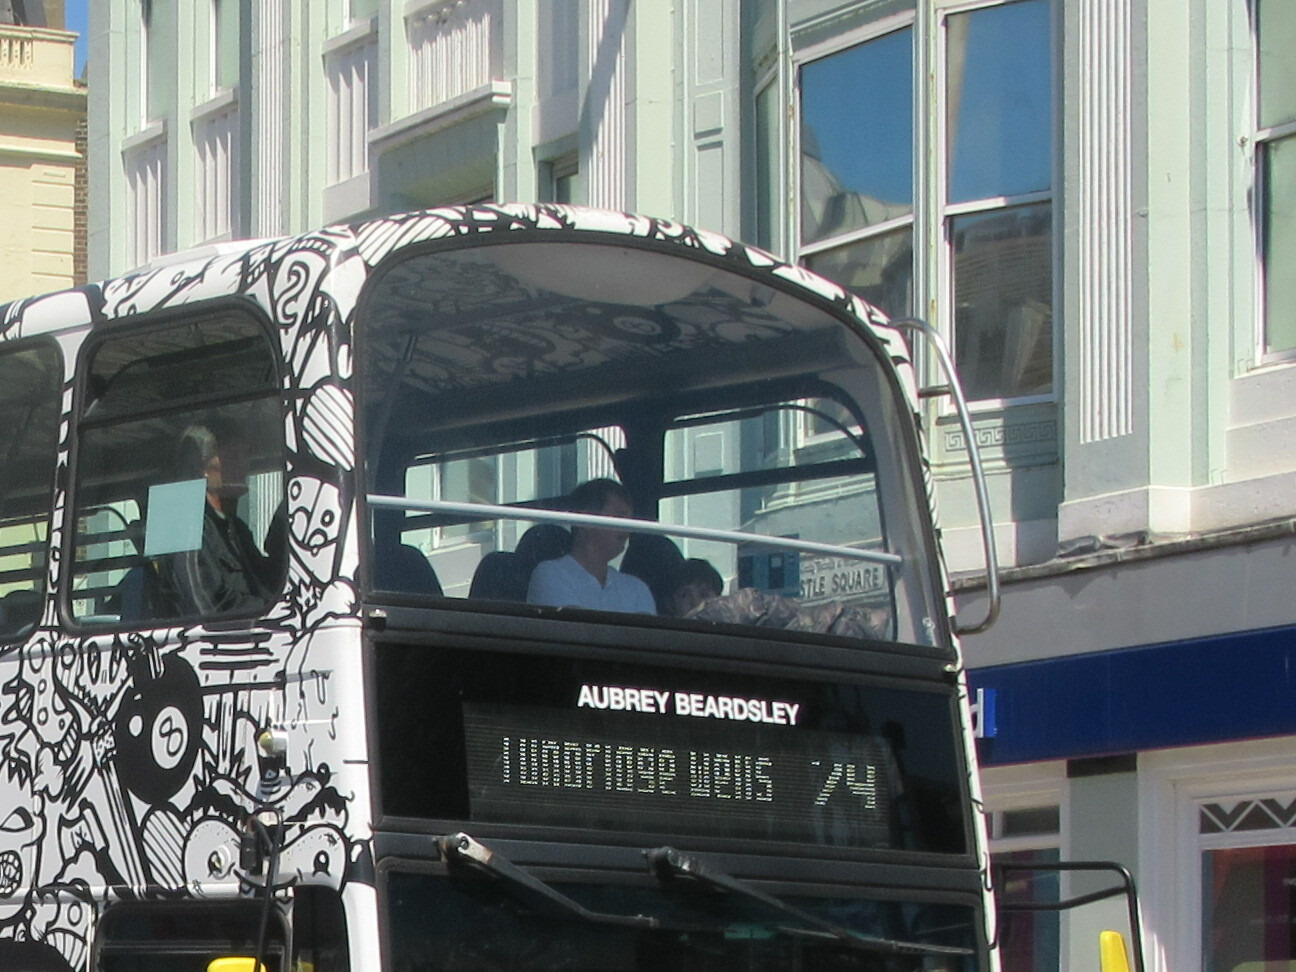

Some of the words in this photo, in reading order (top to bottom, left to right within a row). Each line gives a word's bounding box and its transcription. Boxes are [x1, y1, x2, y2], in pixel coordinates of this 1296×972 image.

[832, 567, 879, 594] SQUARE
[577, 684, 670, 714] AUBREY
[674, 692, 800, 726] BEARDSLEY
